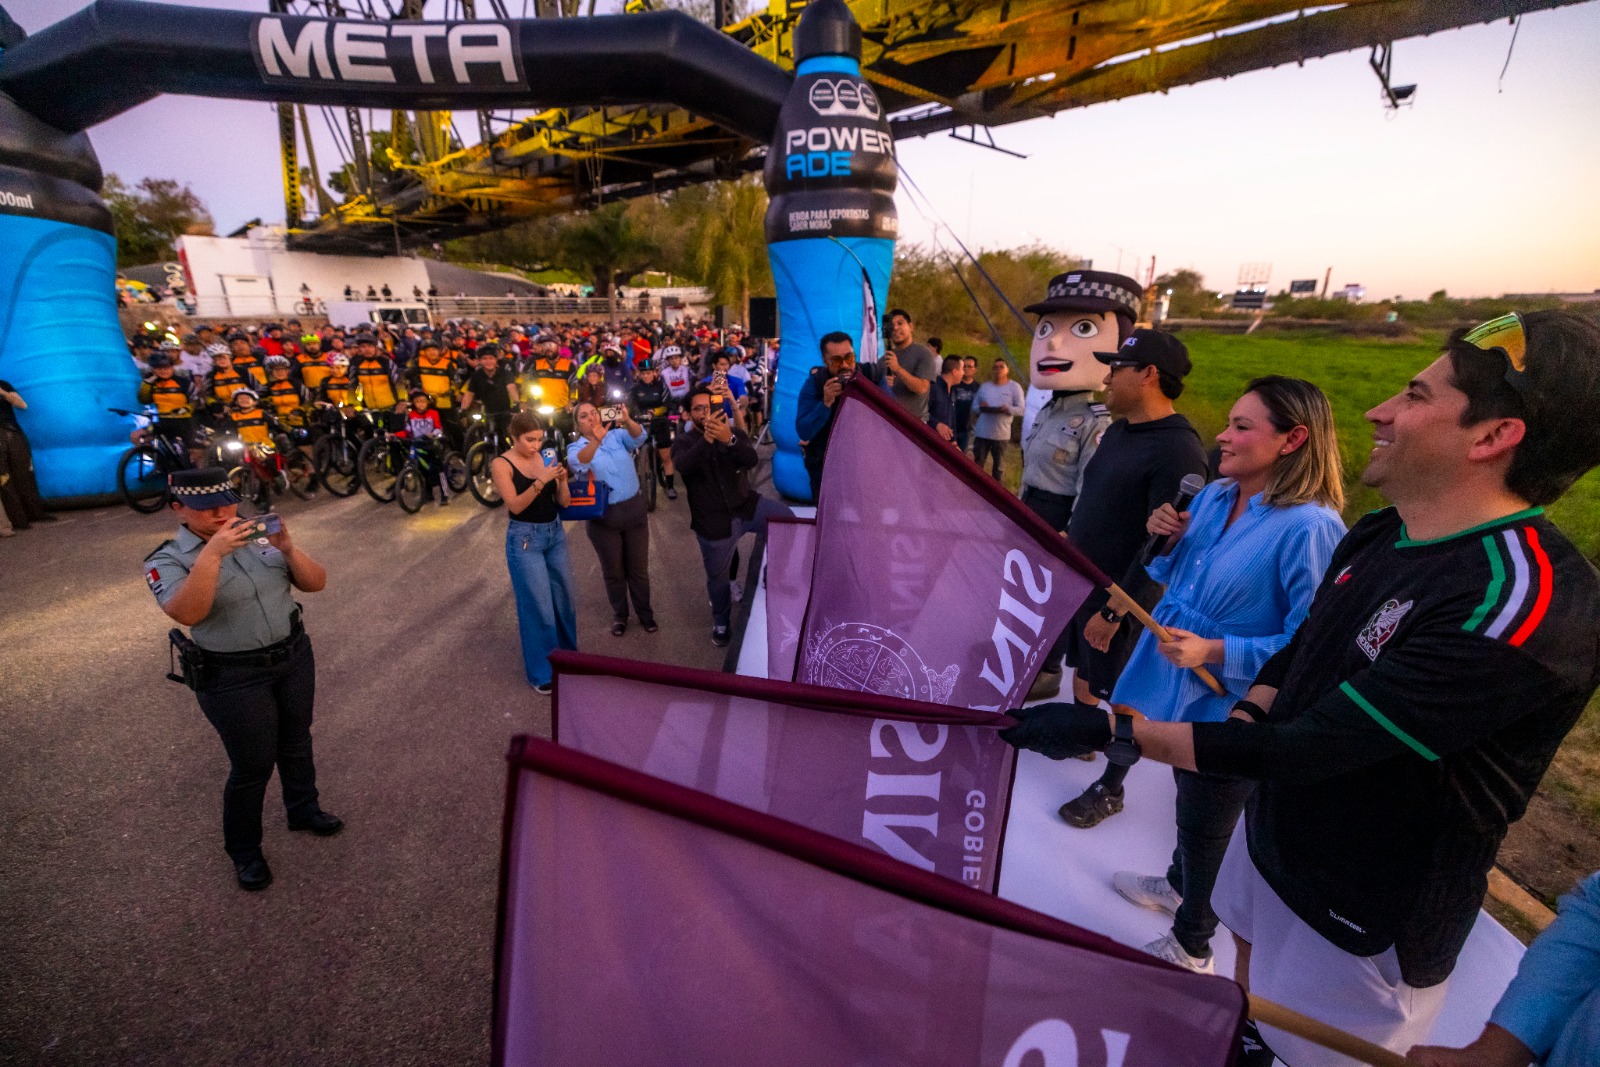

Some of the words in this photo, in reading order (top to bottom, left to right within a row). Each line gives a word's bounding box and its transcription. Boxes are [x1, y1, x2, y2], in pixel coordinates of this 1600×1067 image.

[258, 17, 519, 84] META
[786, 127, 893, 155] POWER
[786, 151, 852, 180] ADE
[811, 209, 827, 219] PARA
